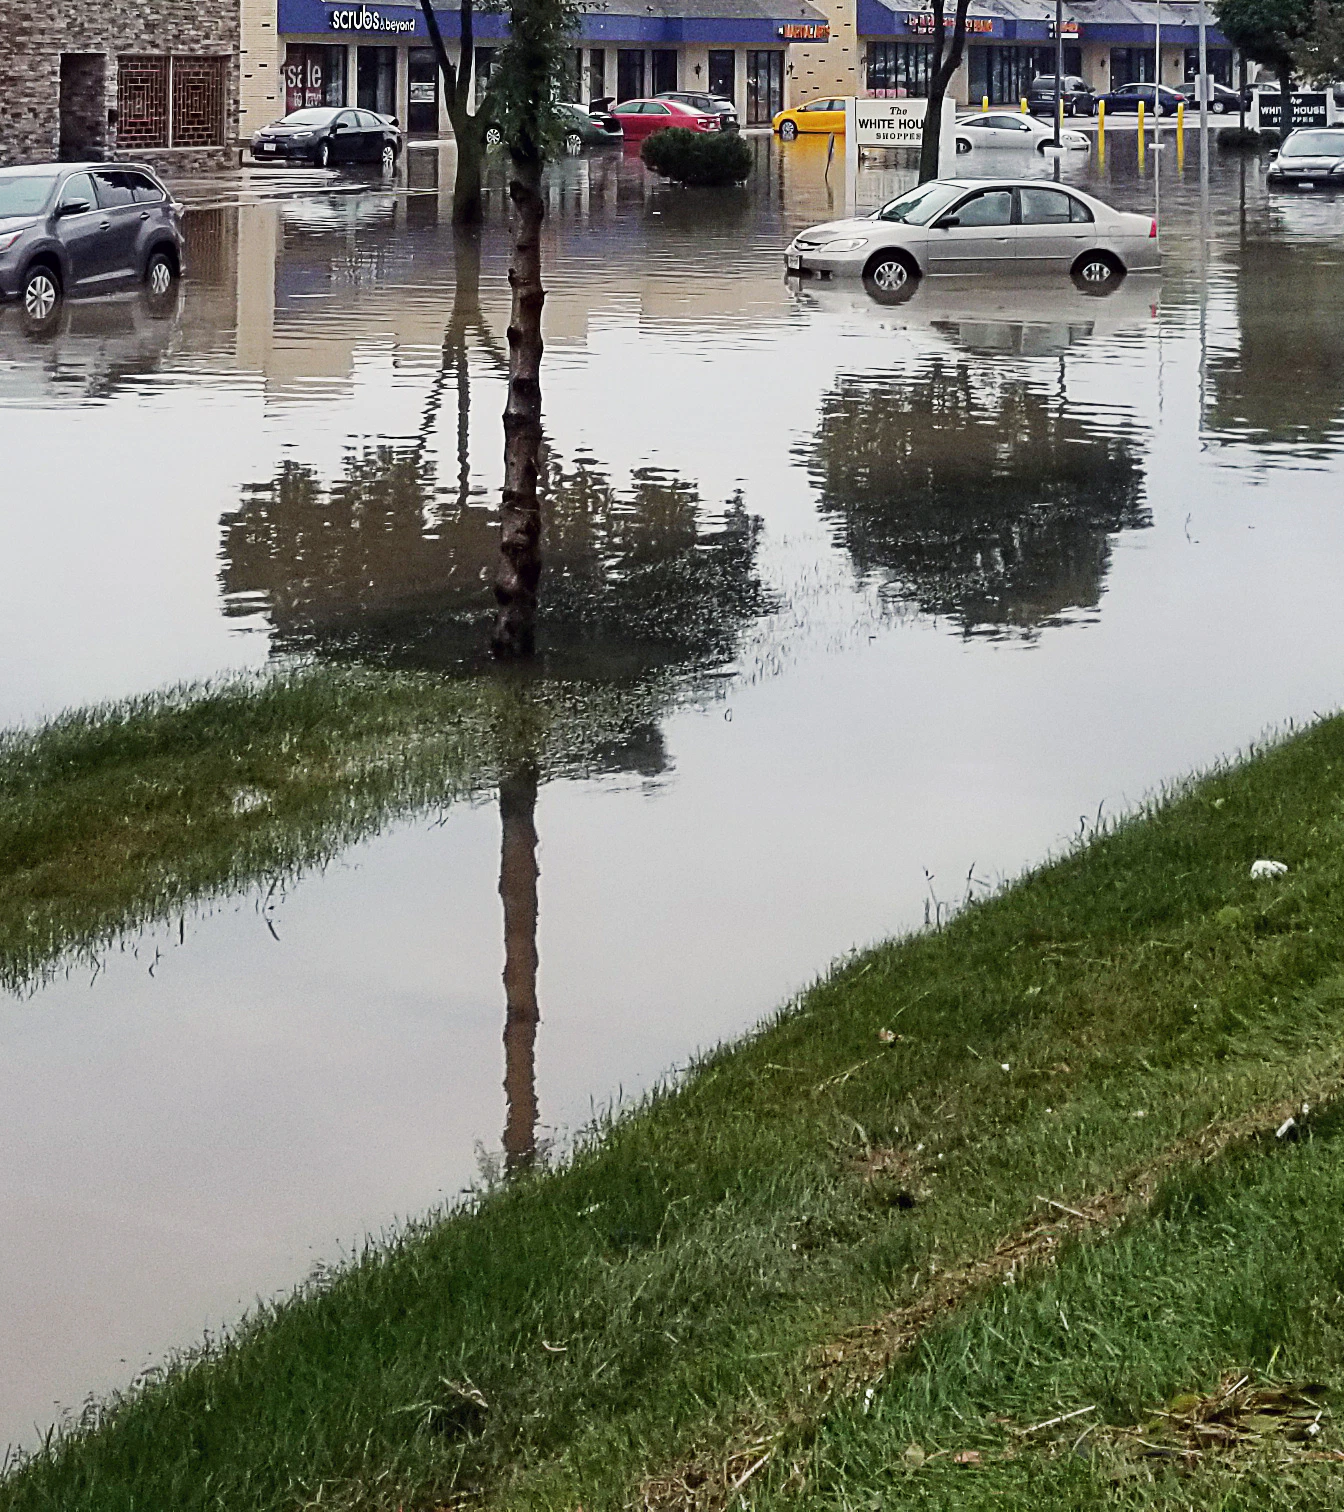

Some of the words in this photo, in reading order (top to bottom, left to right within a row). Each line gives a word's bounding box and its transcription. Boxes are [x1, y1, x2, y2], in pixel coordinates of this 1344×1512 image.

[333, 5, 380, 29] scrubs
[386, 18, 415, 33] beyond
[1290, 96, 1302, 105] he
[890, 106, 908, 115] The
[1260, 106, 1281, 115] WHIT
[1293, 106, 1325, 115] HOUSE
[859, 119, 894, 129] WHITE
[899, 119, 923, 129] HOU
[876, 132, 921, 140] SHOPPES
